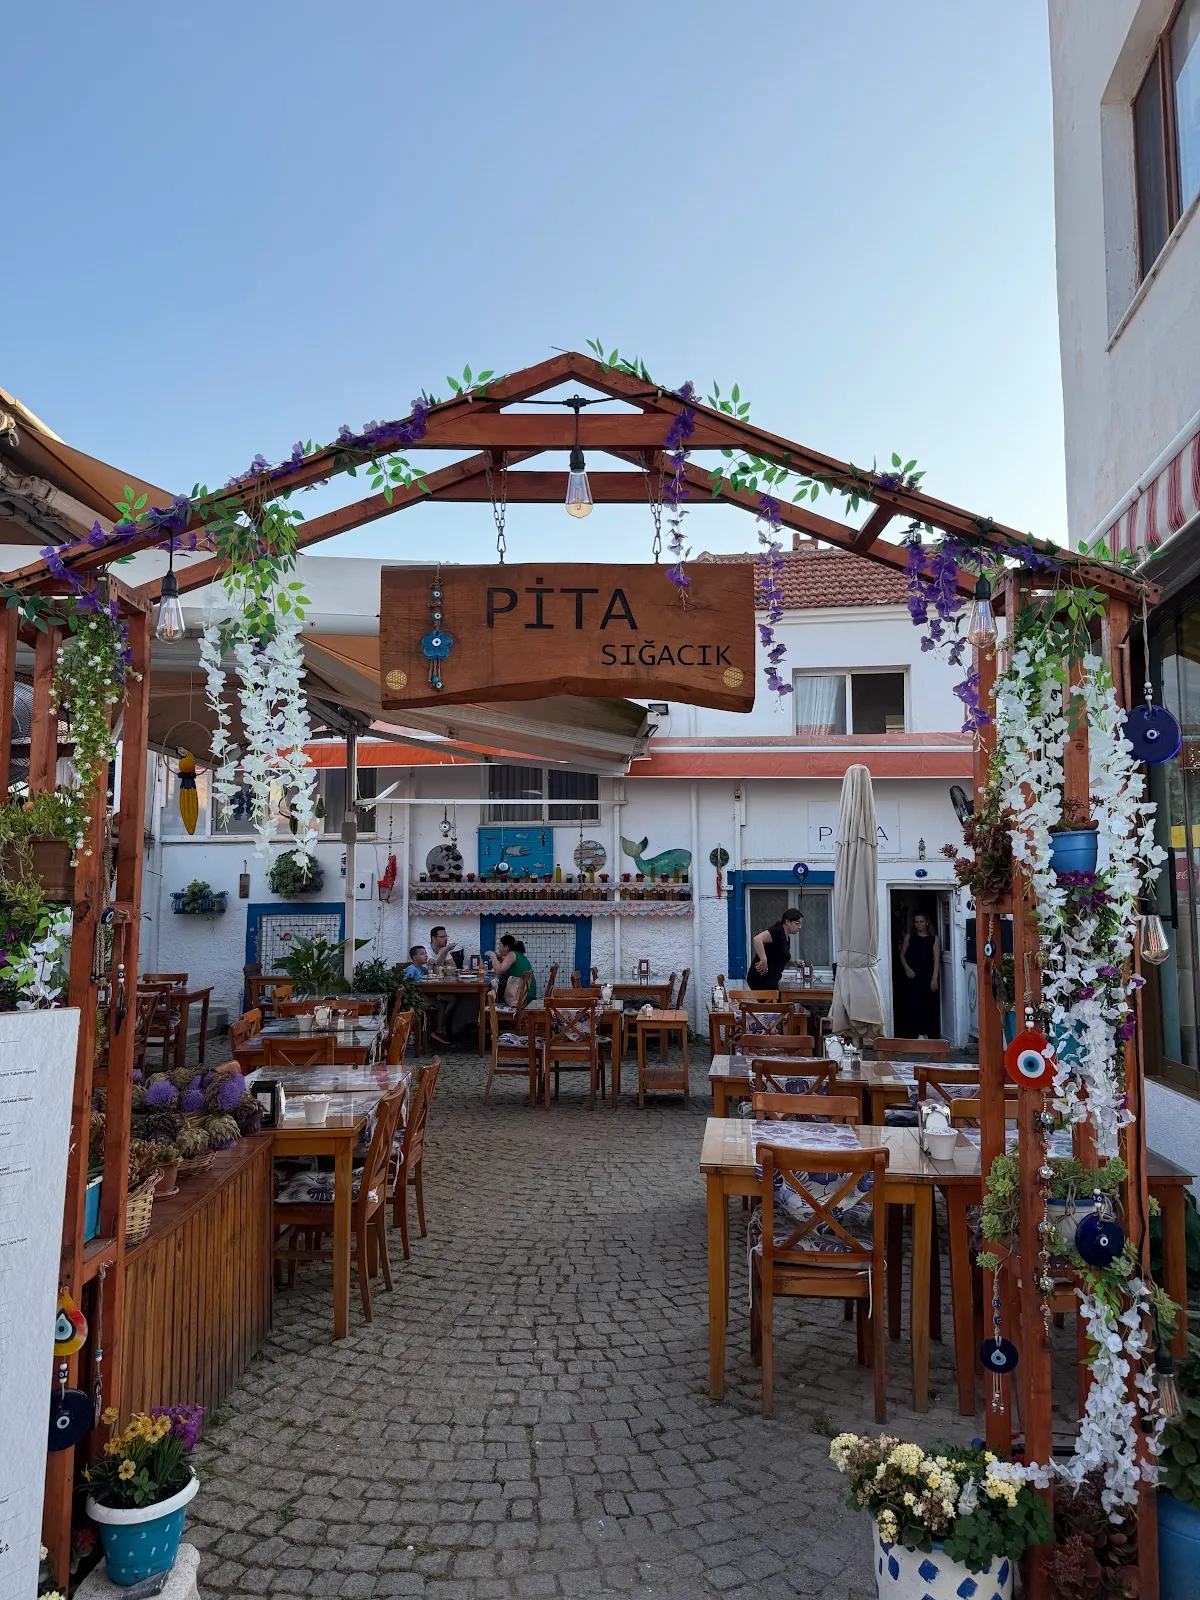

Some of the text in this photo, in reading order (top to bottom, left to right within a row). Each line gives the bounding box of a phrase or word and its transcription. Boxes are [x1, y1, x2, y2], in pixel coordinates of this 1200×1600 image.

[486, 577, 638, 630] PİTA
[601, 640, 733, 666] SIĞACIK
[819, 826, 889, 842] PA
